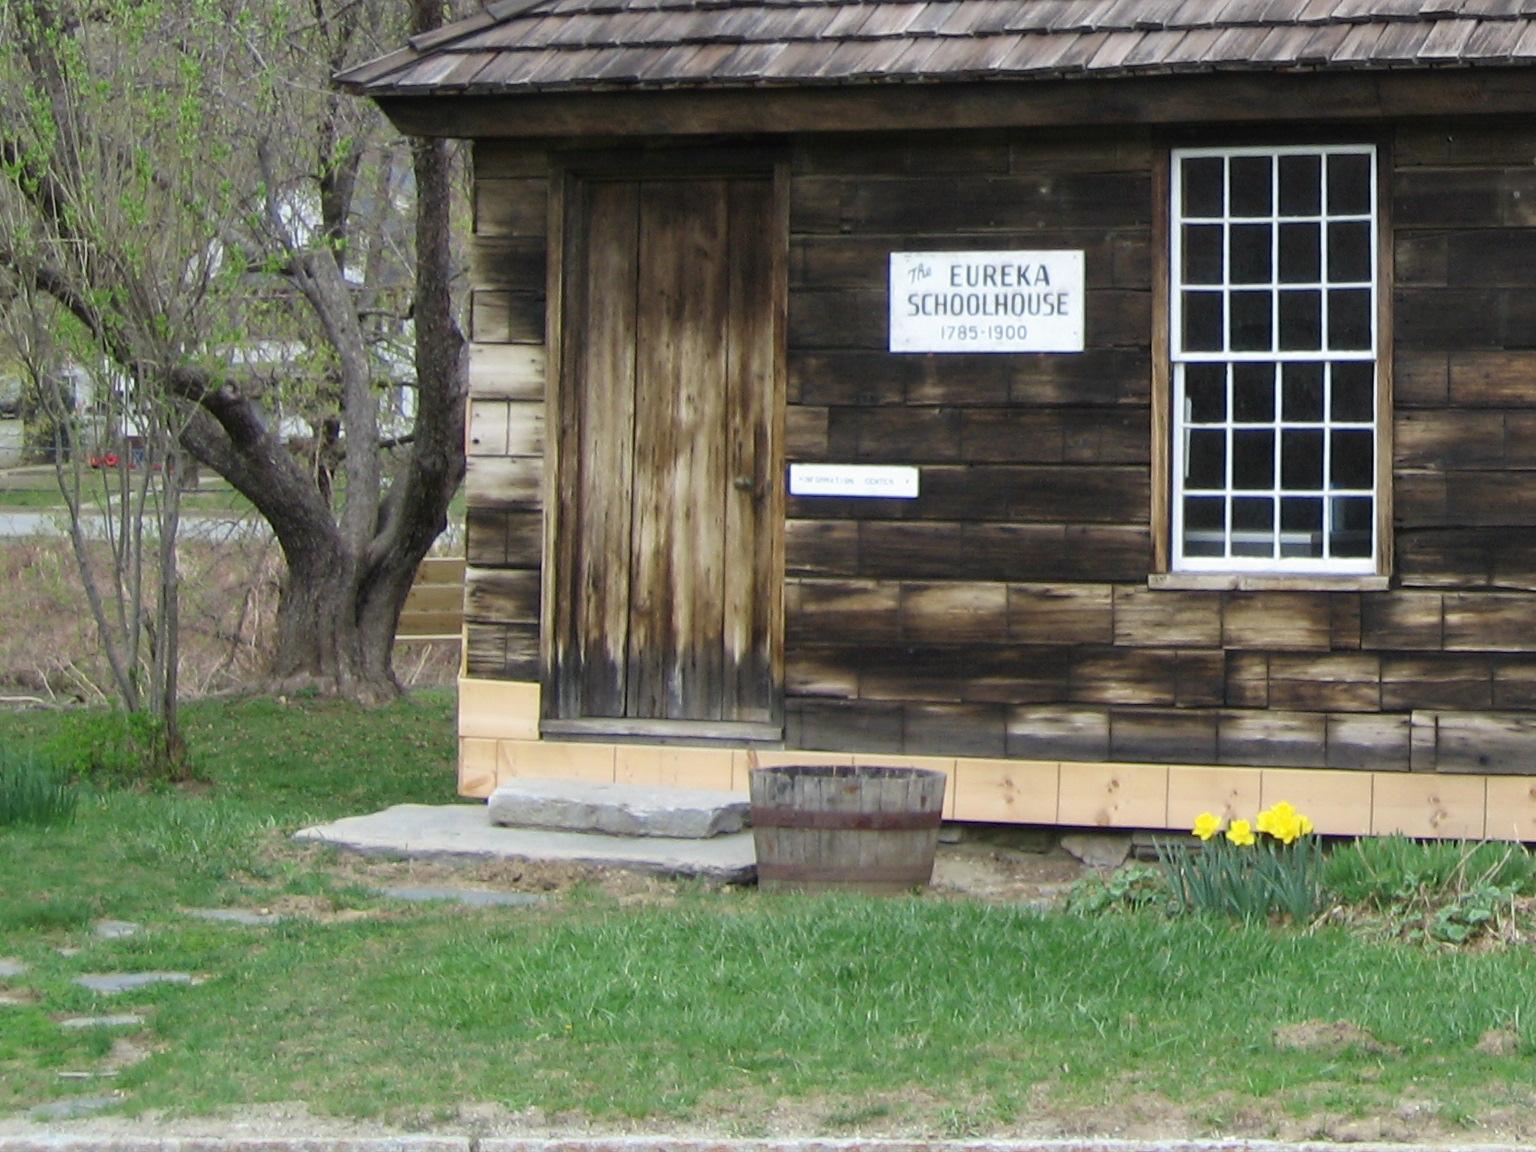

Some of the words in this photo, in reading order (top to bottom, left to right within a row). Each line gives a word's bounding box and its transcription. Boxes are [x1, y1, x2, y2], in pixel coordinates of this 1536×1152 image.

[908, 263, 932, 284] The
[950, 264, 1050, 287] EUREKA
[908, 293, 1069, 316] SCHOOLHOUSE
